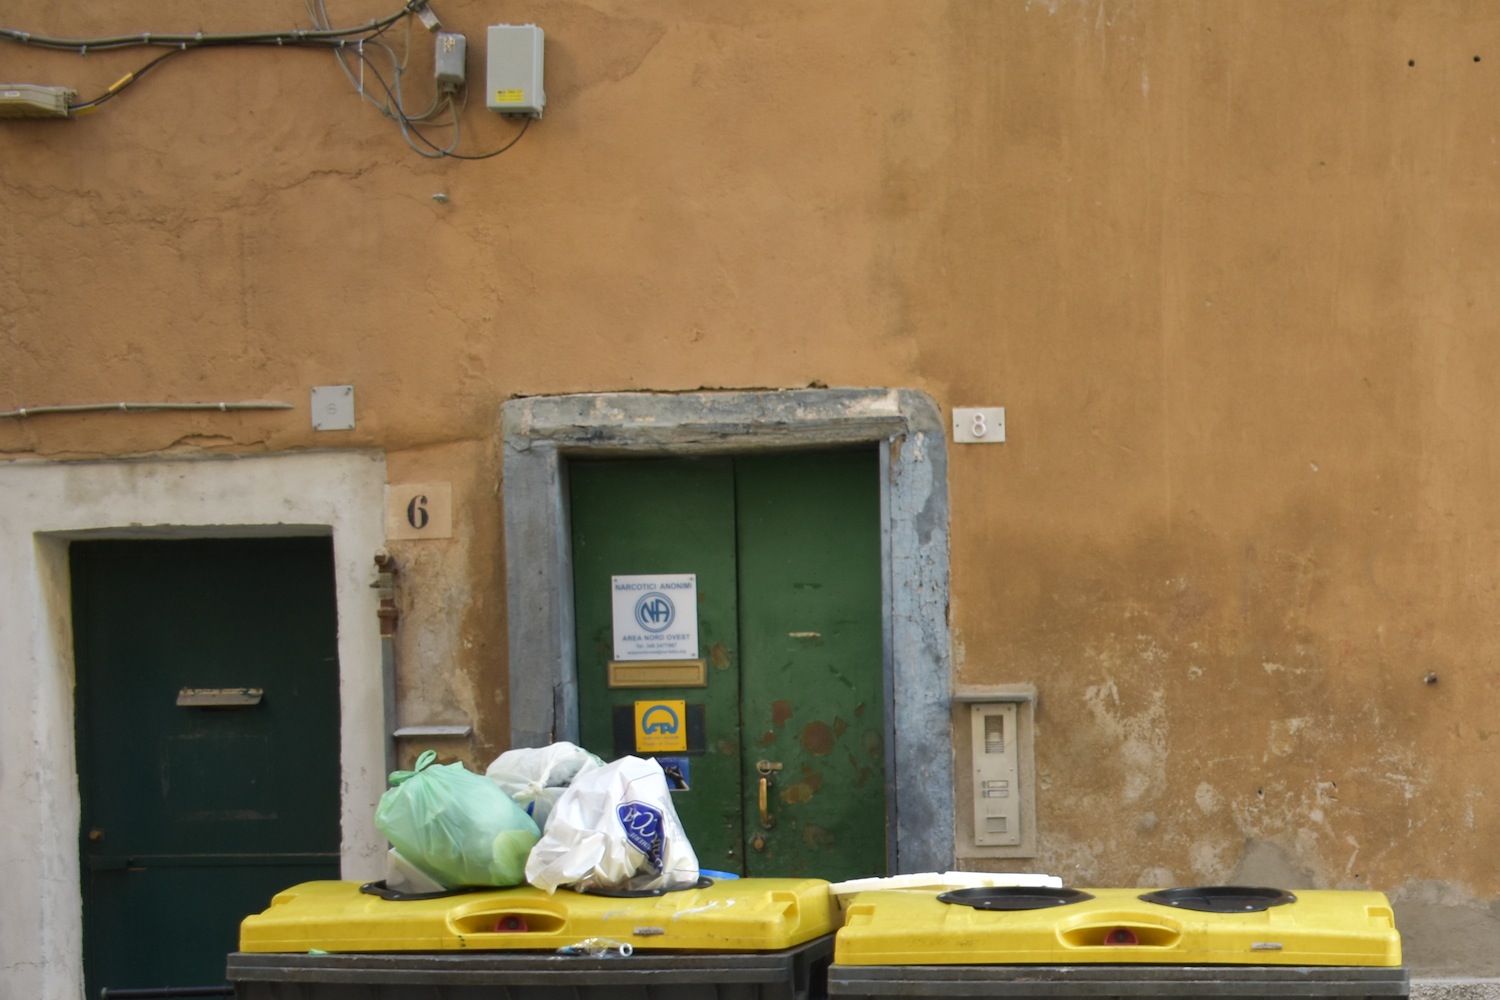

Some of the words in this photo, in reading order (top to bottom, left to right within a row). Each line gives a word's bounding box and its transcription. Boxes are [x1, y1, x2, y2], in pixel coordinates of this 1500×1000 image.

[972, 413, 987, 438] 8
[407, 495, 429, 529] 6
[615, 583, 657, 591] NARCOTICI
